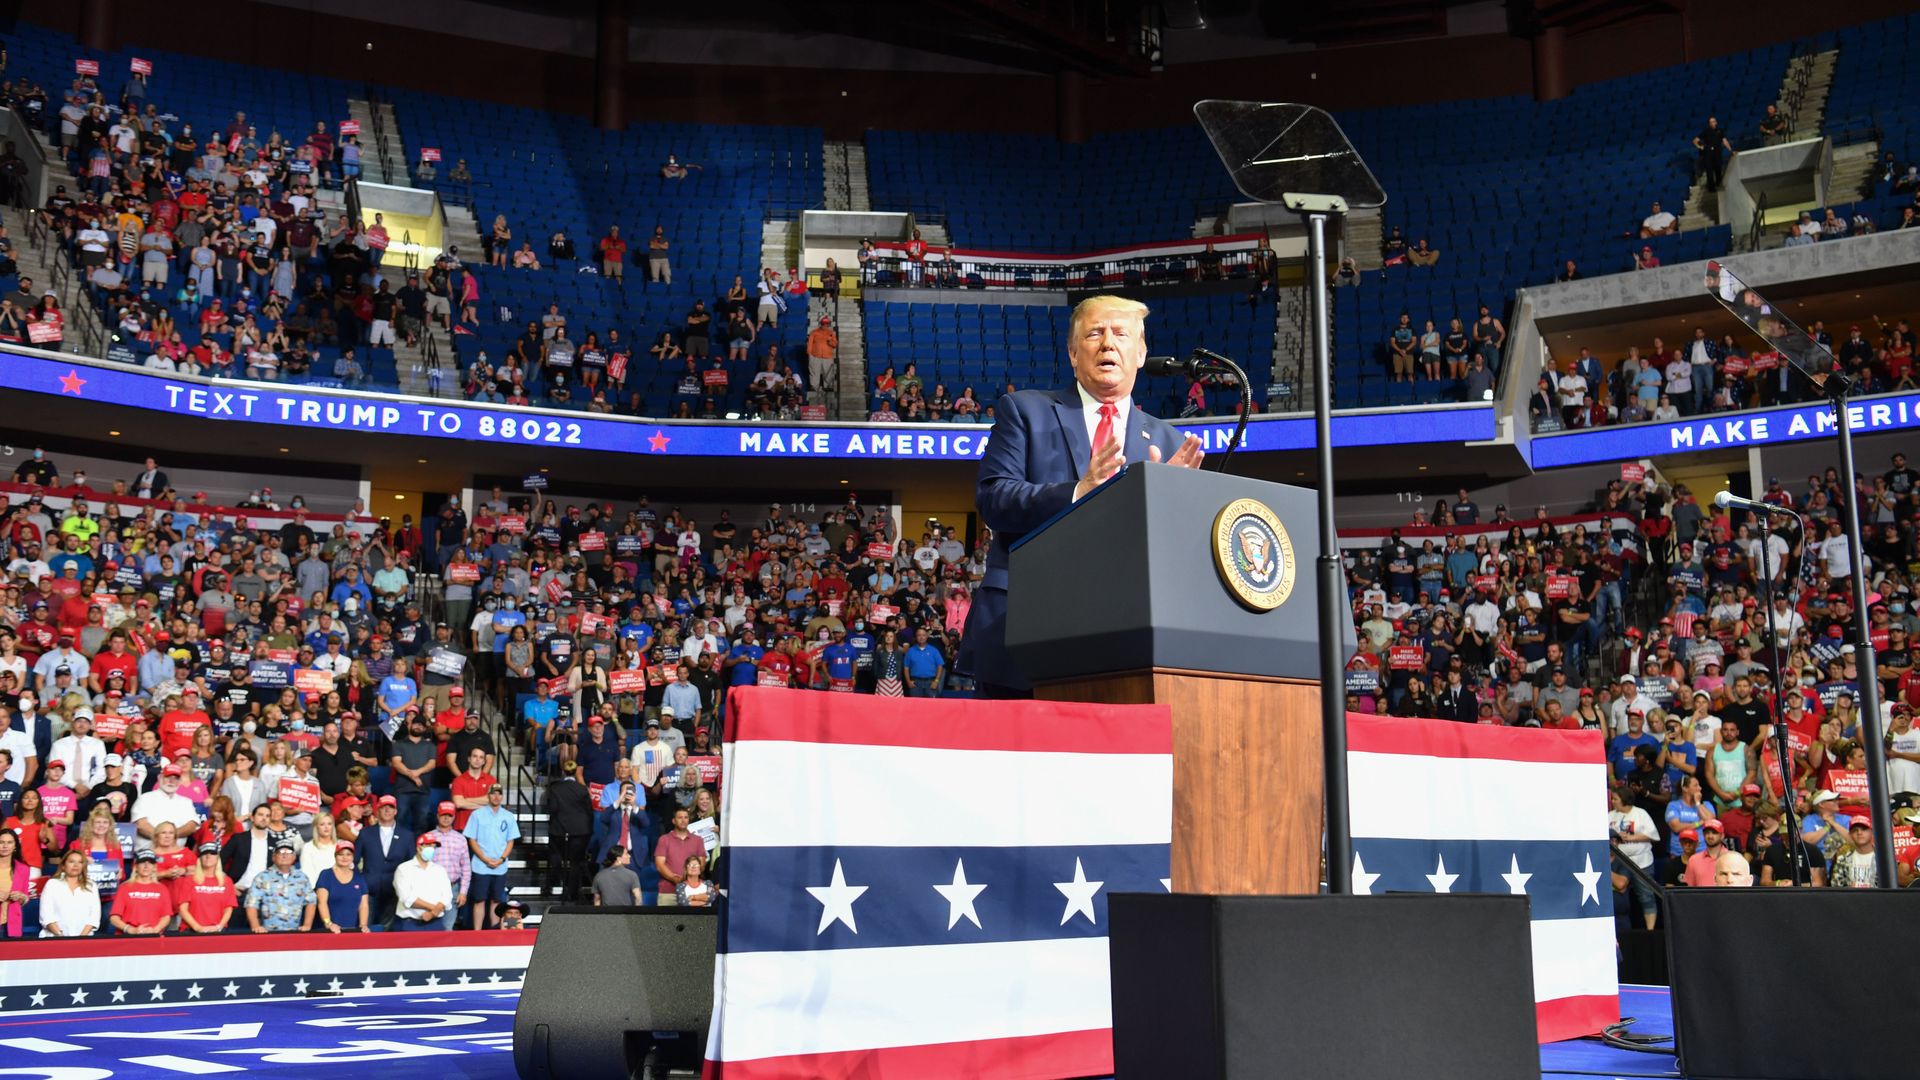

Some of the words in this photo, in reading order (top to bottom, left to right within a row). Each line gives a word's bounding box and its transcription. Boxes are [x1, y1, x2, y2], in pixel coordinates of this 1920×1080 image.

[164, 385, 259, 417] TEXT
[277, 398, 401, 429] TRUMP
[418, 410, 462, 434] TO
[478, 416, 582, 444] 88022
[740, 431, 830, 453] MAKE
[1671, 418, 1768, 448] MAKE
[791, 503, 816, 513] 114
[1221, 503, 1252, 542] PRESIDENT
[1275, 523, 1292, 569] UNITED
[1266, 577, 1290, 604] STATES
[282, 788, 317, 802] AMERICA
